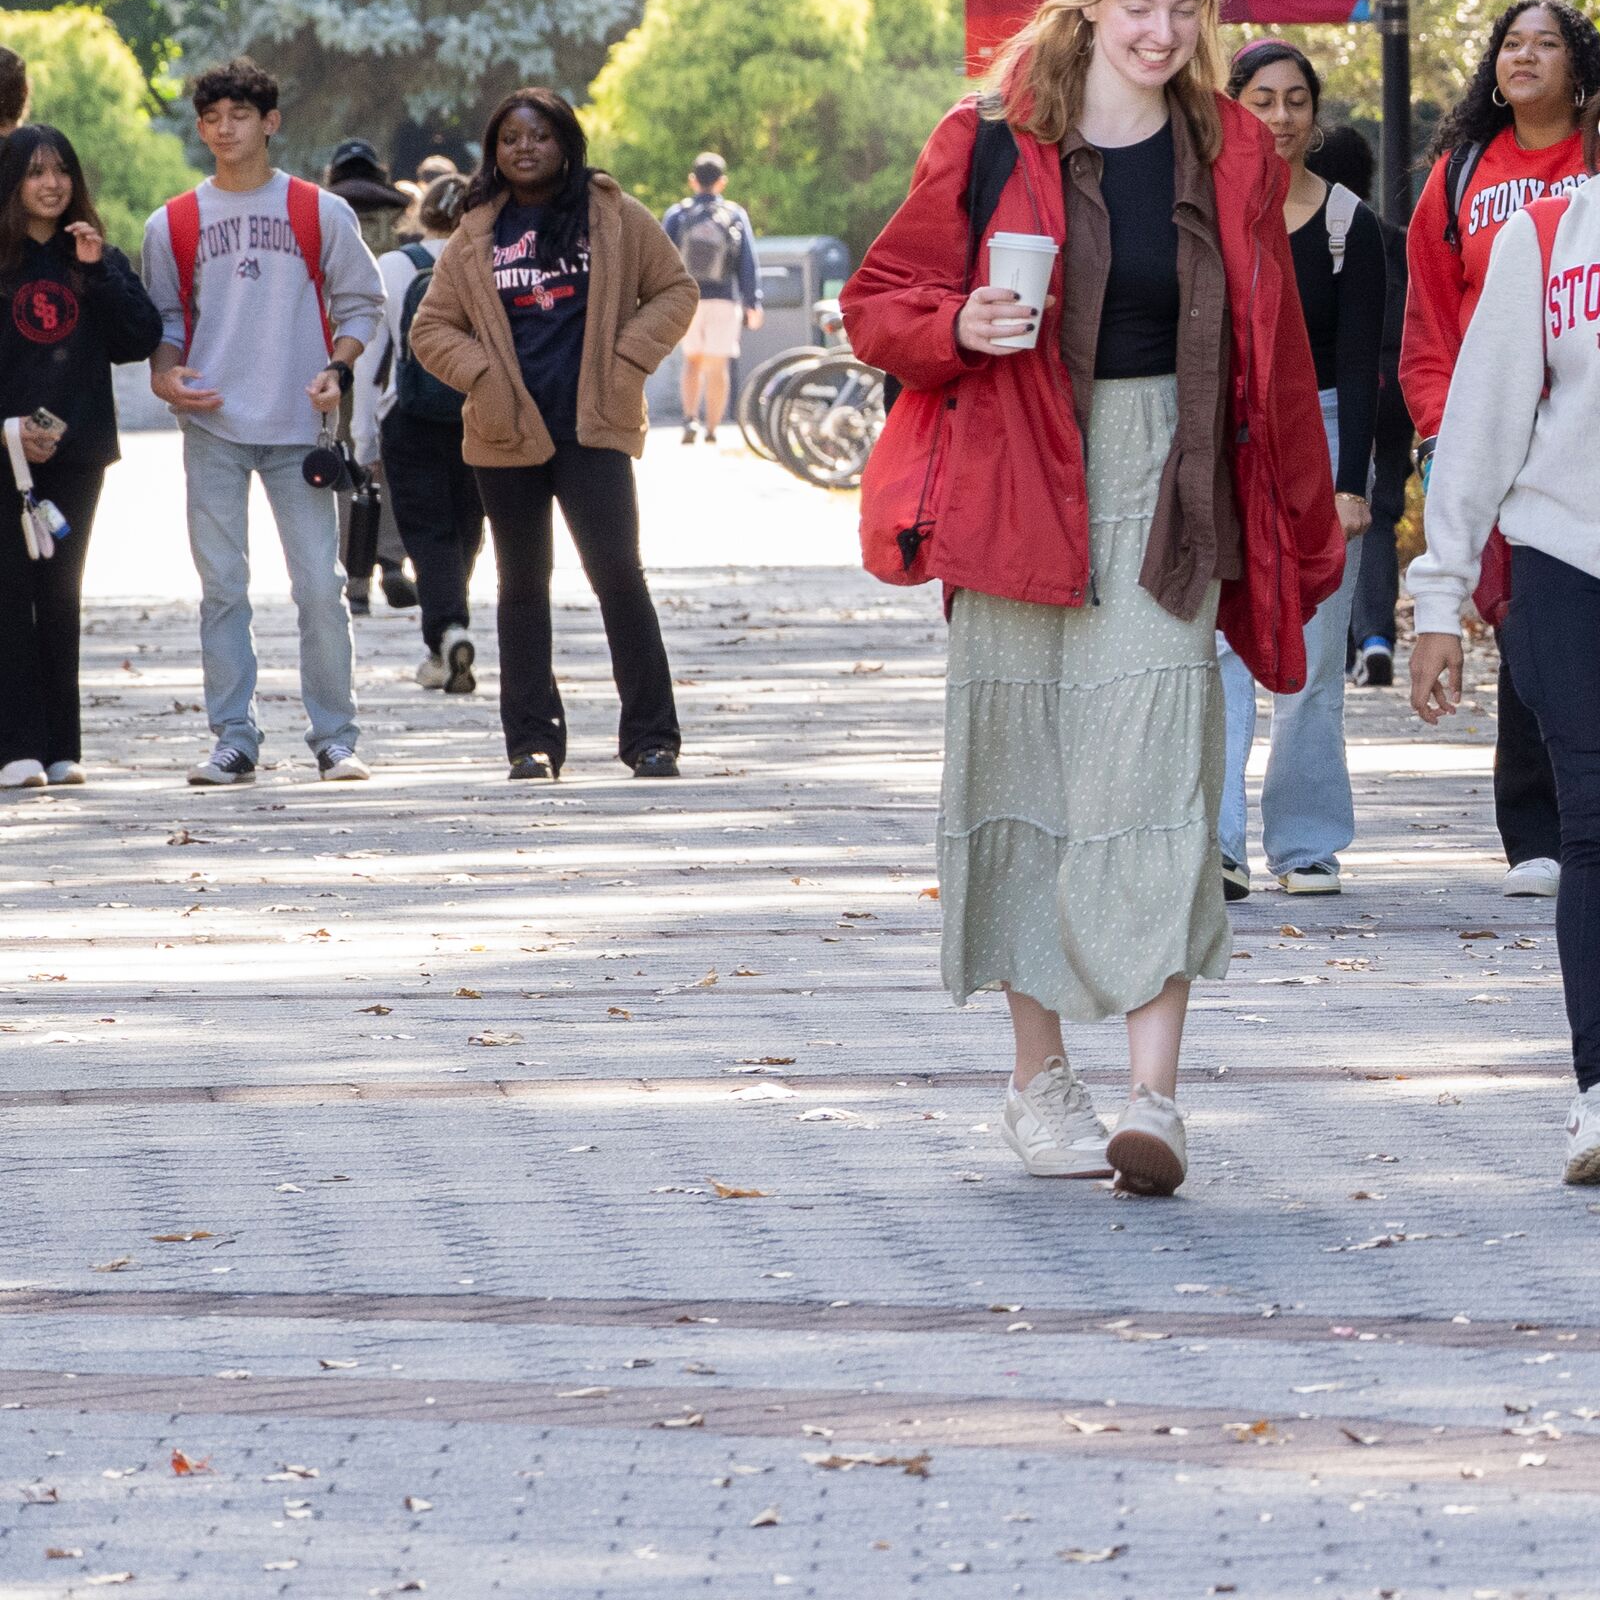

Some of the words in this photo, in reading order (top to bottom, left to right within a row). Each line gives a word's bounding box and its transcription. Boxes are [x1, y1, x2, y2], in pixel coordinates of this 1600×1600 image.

[1468, 178, 1545, 236] STONY
[195, 215, 242, 268] TONY
[248, 214, 305, 257] BROO
